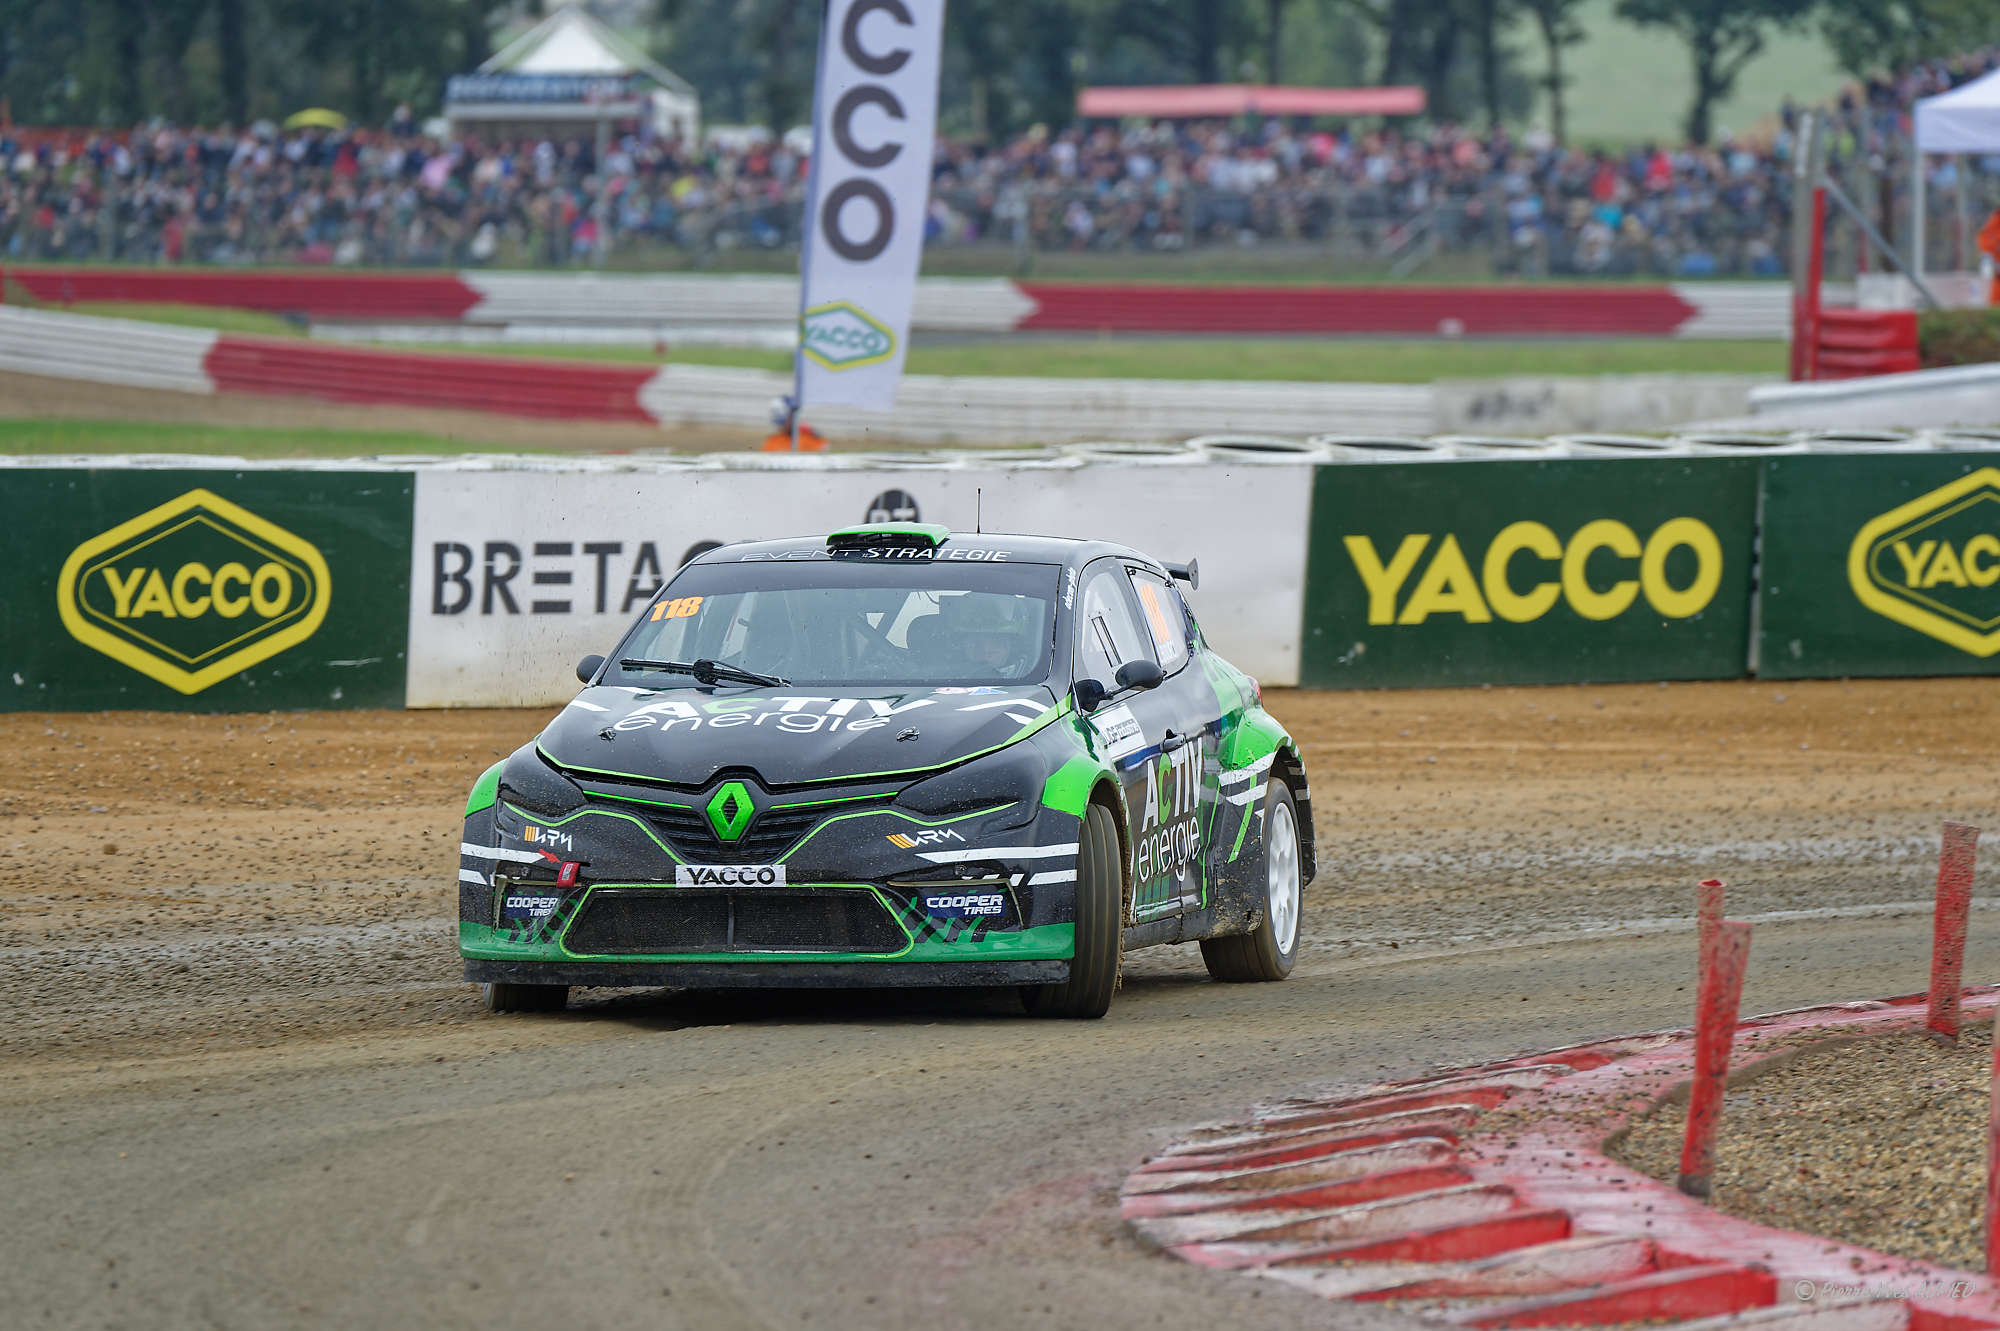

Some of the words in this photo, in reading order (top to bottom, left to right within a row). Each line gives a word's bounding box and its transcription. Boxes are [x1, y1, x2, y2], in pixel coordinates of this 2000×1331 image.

[741, 549, 860, 562] EVENT
[1892, 534, 2000, 588] YAC
[1343, 517, 1723, 625] YACCO
[102, 562, 292, 619] YACCO
[650, 597, 704, 622] 118
[624, 696, 935, 719] ACTIV
[614, 712, 892, 733] energie
[1142, 737, 1204, 833] ACTIV
[1138, 816, 1201, 883] energie
[686, 866, 776, 886] YACCO
[506, 896, 558, 909] COOPER
[926, 895, 1004, 908] COOPER
[963, 905, 1002, 916] TIRES
